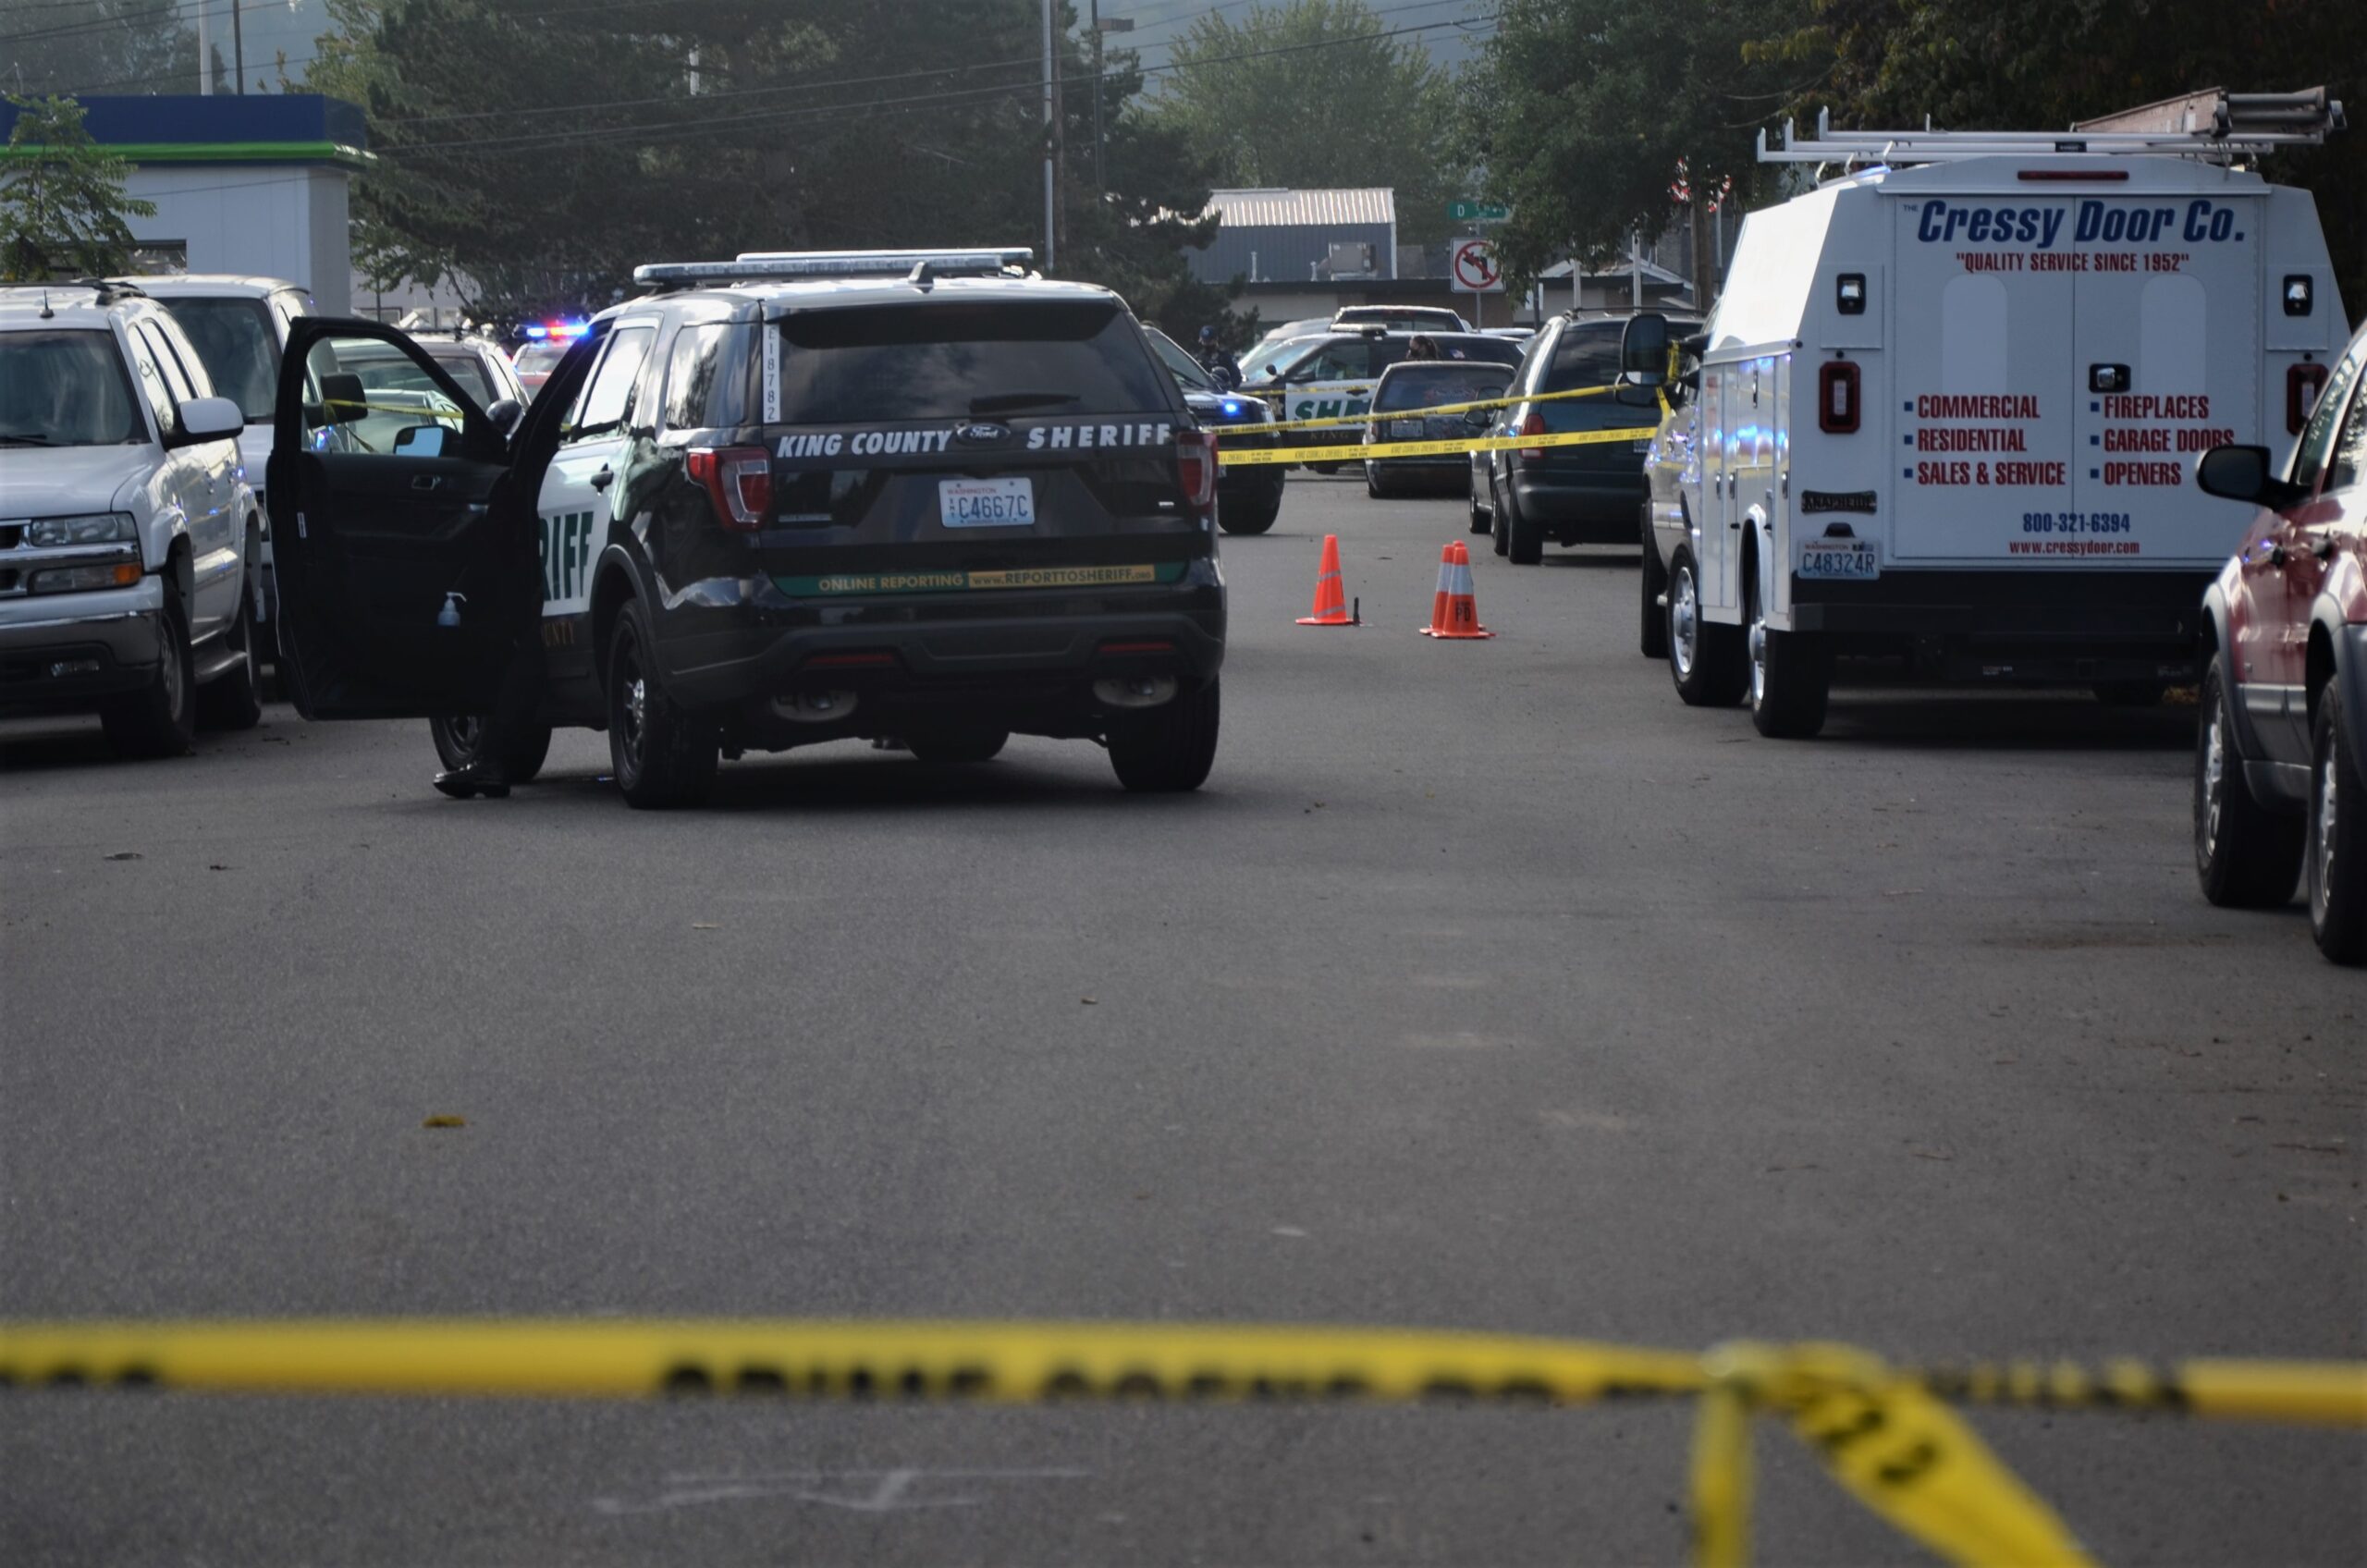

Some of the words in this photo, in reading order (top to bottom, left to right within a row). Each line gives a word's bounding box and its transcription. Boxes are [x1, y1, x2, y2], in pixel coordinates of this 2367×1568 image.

[1918, 200, 2065, 249] Cressy
[2074, 200, 2175, 242] Door
[2183, 199, 2244, 242] Co.
[1956, 252, 2024, 273] "QUALITY
[2030, 252, 2088, 272] SERVICE
[2094, 252, 2137, 272] SINCE
[2144, 252, 2189, 272] 1952"
[767, 327, 776, 420] E18782
[1918, 395, 2041, 419] COMMERCIAL
[2104, 395, 2209, 419] FIREPLACES
[970, 425, 999, 438] Ford
[1026, 423, 1171, 449] SHERIFF
[1918, 428, 2027, 452] RESIDENTIAL
[2104, 428, 2171, 452] GARAGE
[2177, 428, 2235, 452] DOORS
[777, 434, 842, 458] KING
[851, 430, 952, 455] COUNTY
[1918, 461, 1970, 485] SALES
[1977, 461, 1990, 485] &
[1995, 461, 2066, 485] SERVICE
[2104, 461, 2182, 485] OPENERS
[958, 495, 1028, 519] C4667C
[2023, 512, 2130, 533] 800-321-6394
[2009, 541, 2140, 556] www.cressydoor.com
[1803, 553, 1875, 573] C48324R
[819, 578, 876, 592] ONLINE
[880, 573, 963, 589] REPORTING
